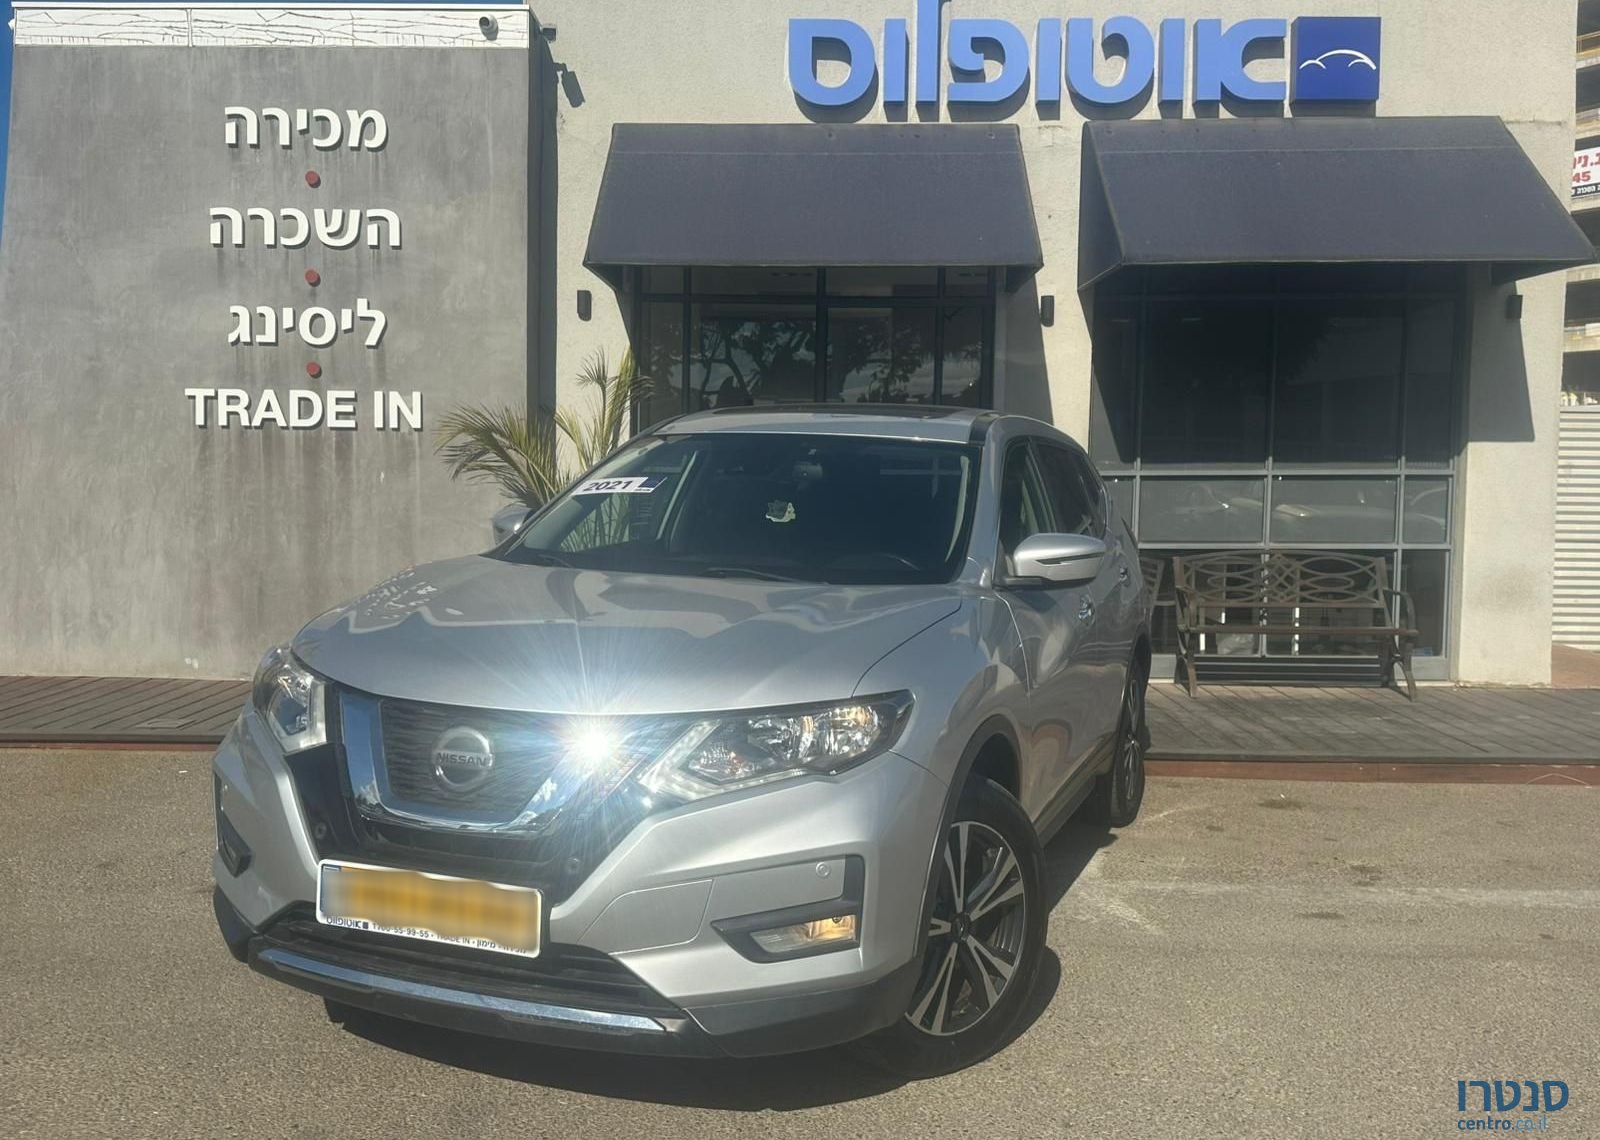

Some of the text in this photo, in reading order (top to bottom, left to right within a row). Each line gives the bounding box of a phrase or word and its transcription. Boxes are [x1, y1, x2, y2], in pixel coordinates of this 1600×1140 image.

[788, 0, 1287, 106] אוטופלוס
[224, 106, 388, 148] מכירה
[209, 206, 401, 247] השכרה
[227, 298, 387, 347] ליסינג
[184, 388, 423, 430] TRADE IN
[583, 480, 633, 491] 2021
[437, 752, 488, 767] NISSAN
